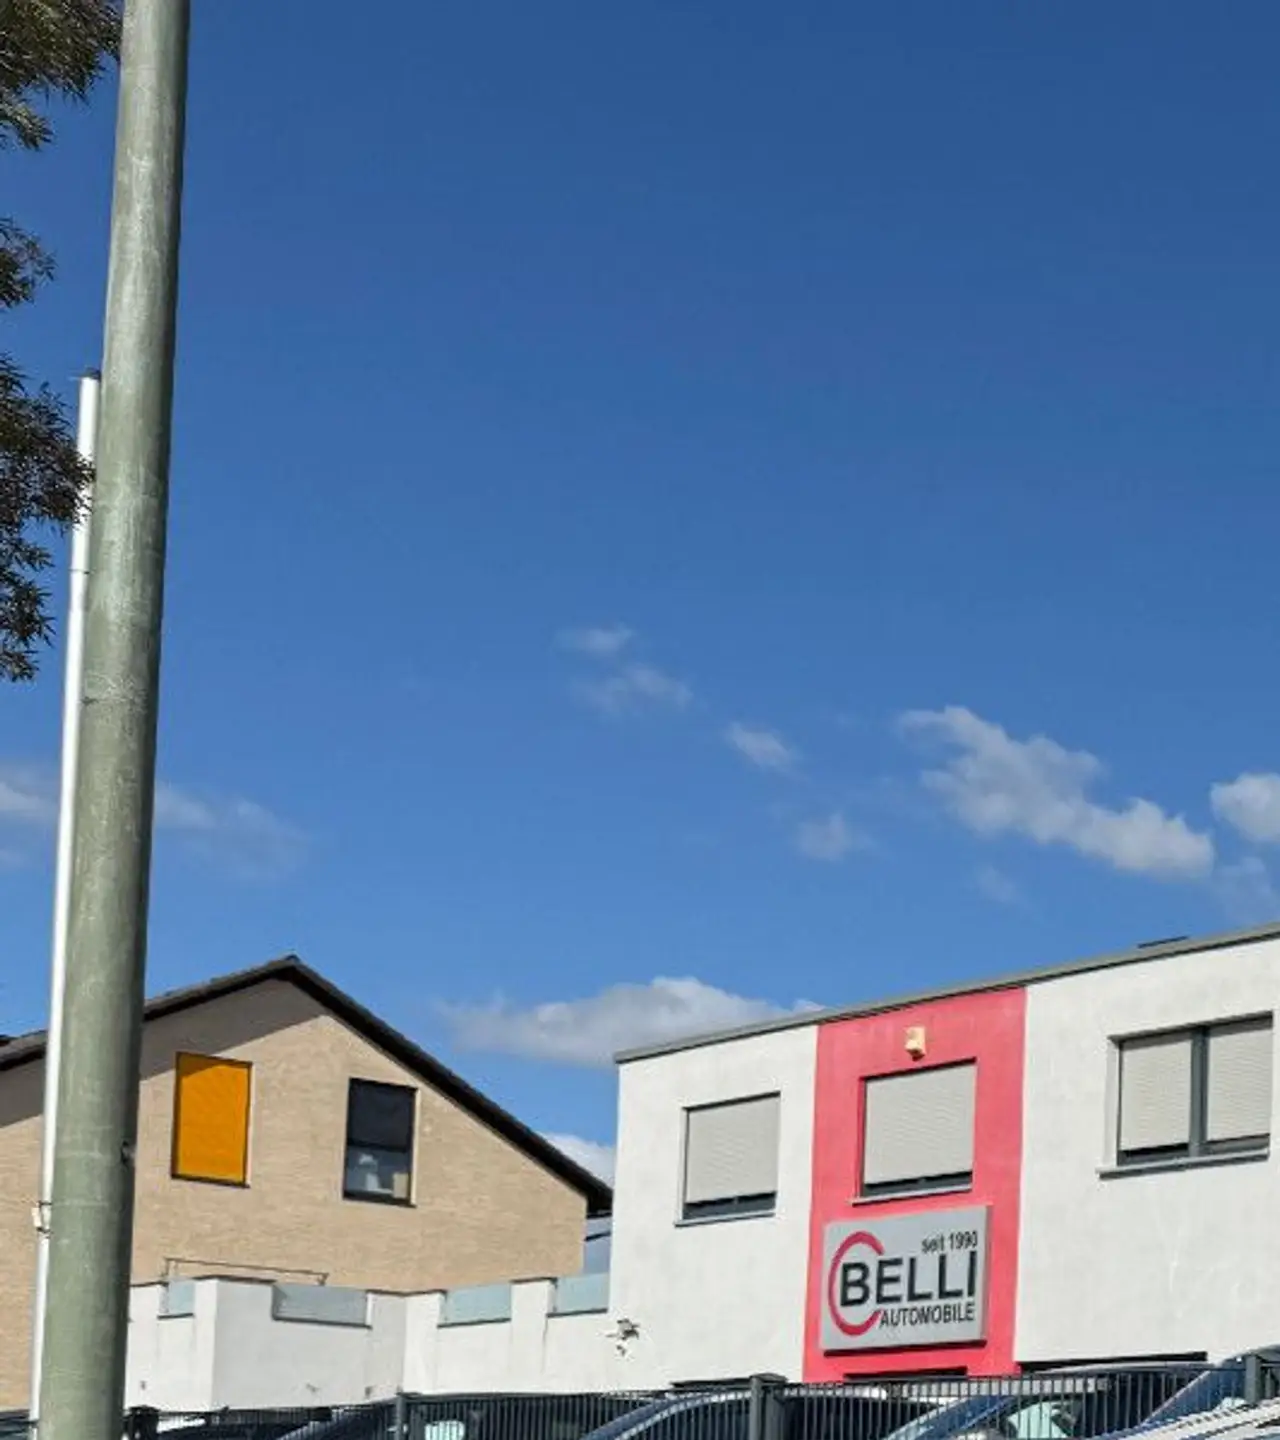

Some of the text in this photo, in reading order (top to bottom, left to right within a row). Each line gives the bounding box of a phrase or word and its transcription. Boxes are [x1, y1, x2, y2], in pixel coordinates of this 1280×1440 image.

[921, 1230, 978, 1253] seit 1990
[840, 1250, 978, 1307] BELLI
[878, 1301, 976, 1329] AUTOMOBILE
